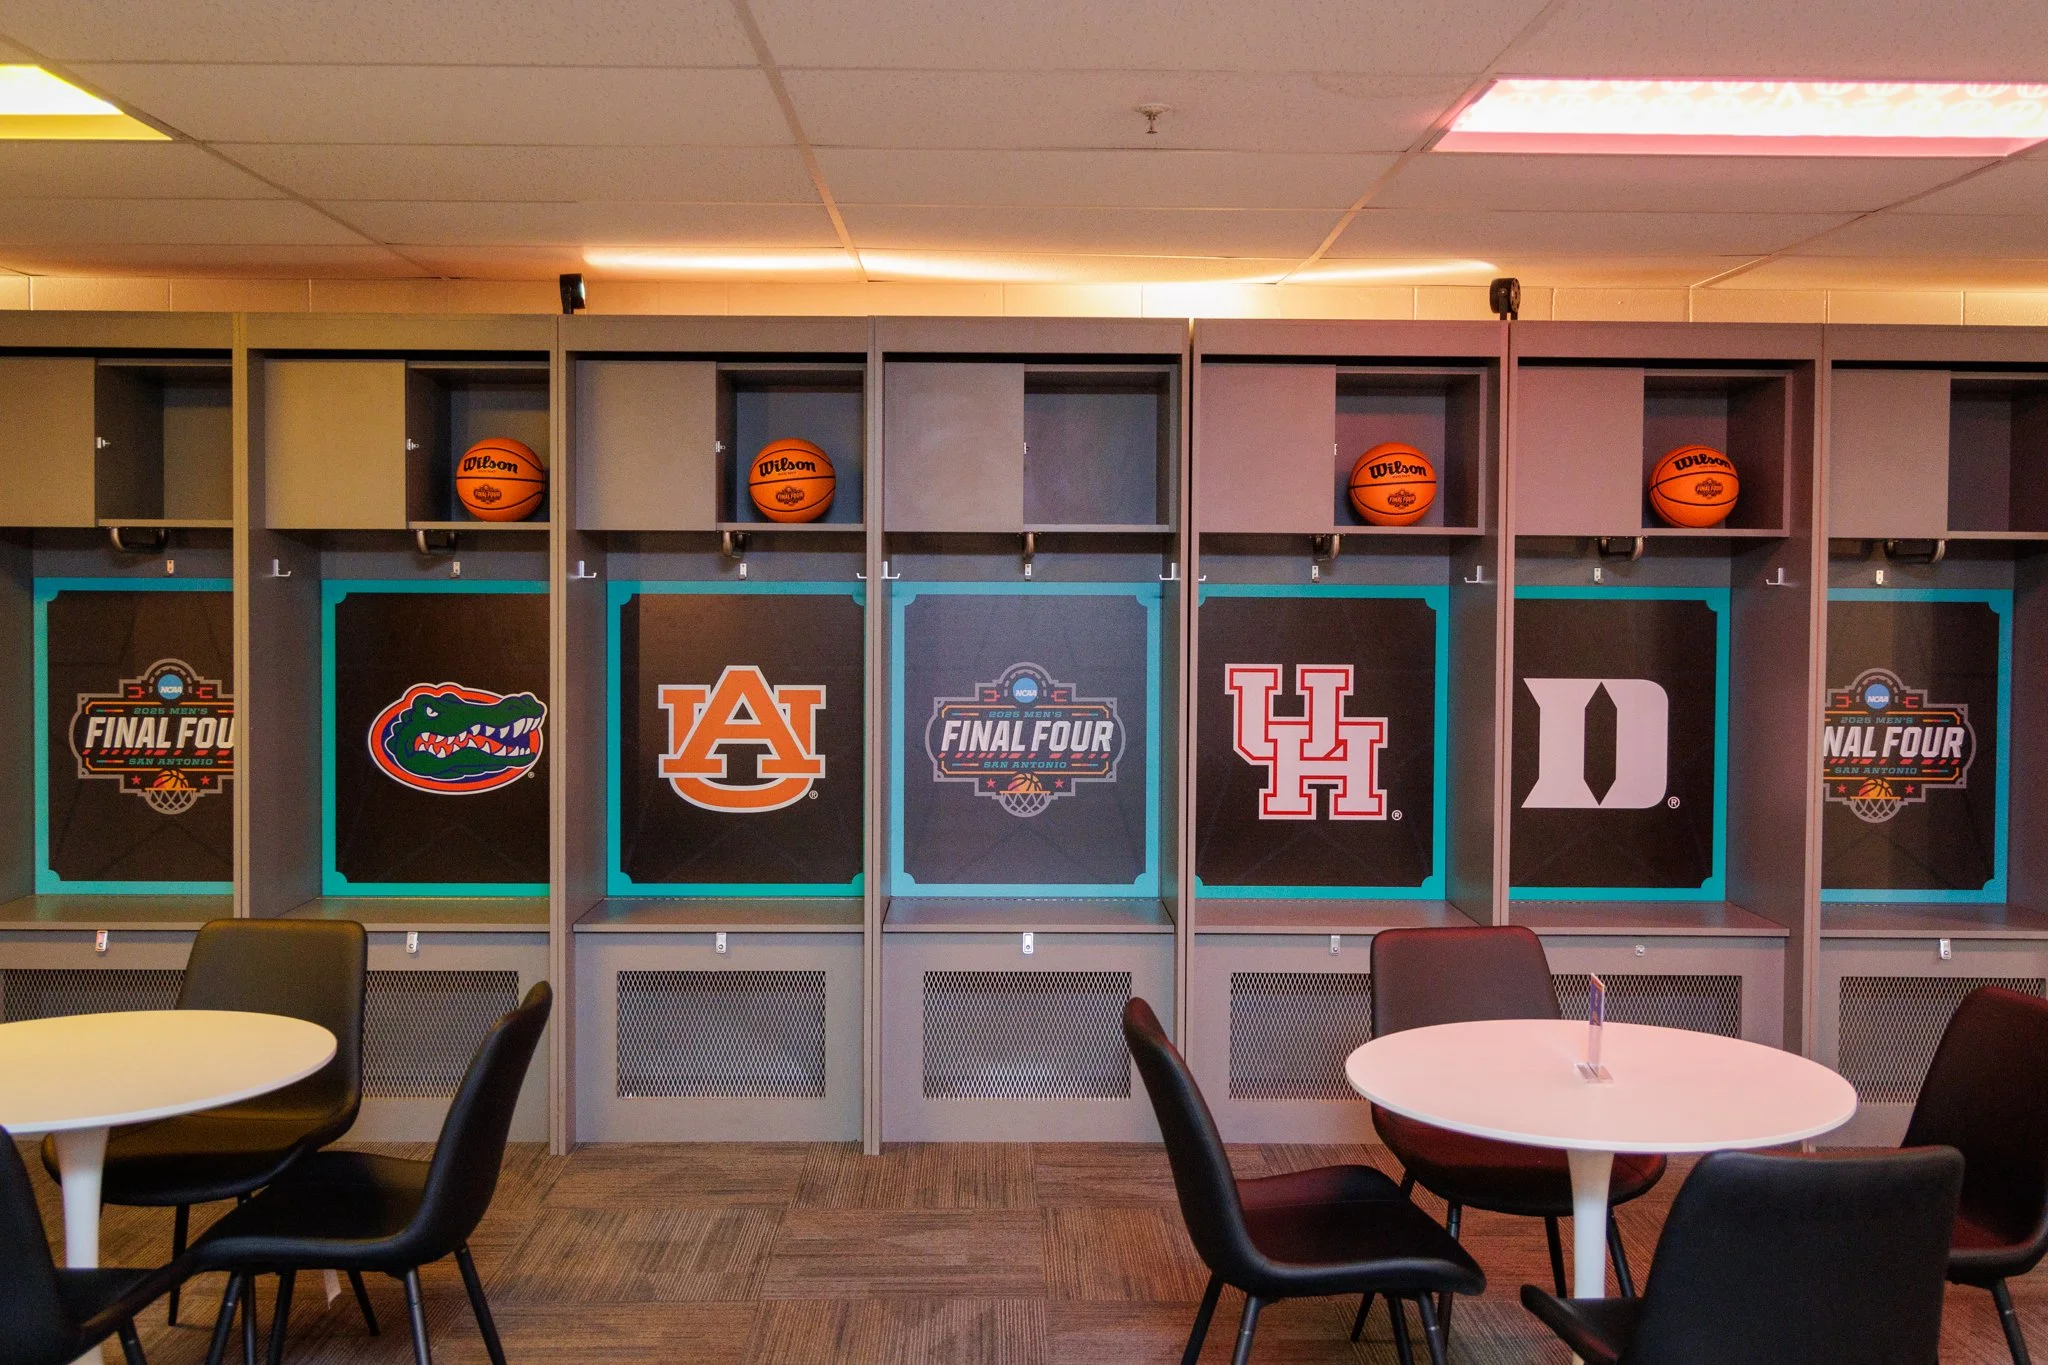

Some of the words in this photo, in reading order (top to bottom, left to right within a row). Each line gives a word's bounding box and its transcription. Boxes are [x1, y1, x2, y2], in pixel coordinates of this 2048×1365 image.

[464, 456, 517, 474] Wilson
[759, 457, 816, 476] Wilson
[1369, 461, 1426, 479] Wilson
[1674, 454, 1730, 470] Wilson
[160, 685, 183, 694] NCAA
[1015, 689, 1038, 697] NCAA
[1867, 695, 1890, 703] NCAA
[133, 707, 165, 715] 2025
[169, 707, 209, 715] MEN'S
[85, 716, 172, 749] FINAL
[176, 716, 235, 749] FOU
[941, 720, 1026, 752] FINAL
[1031, 720, 1115, 752] FOUR
[1521, 678, 1669, 809] D
[1823, 726, 1877, 758] NAL
[1882, 726, 1965, 758] FOUR
[128, 758, 154, 766] SAN
[159, 758, 214, 766] ANTONIO
[983, 761, 1008, 769] SAN
[1011, 761, 1068, 769] ANTONIO
[1834, 767, 1859, 775] SAN
[1863, 767, 1918, 775] ANTONIO
